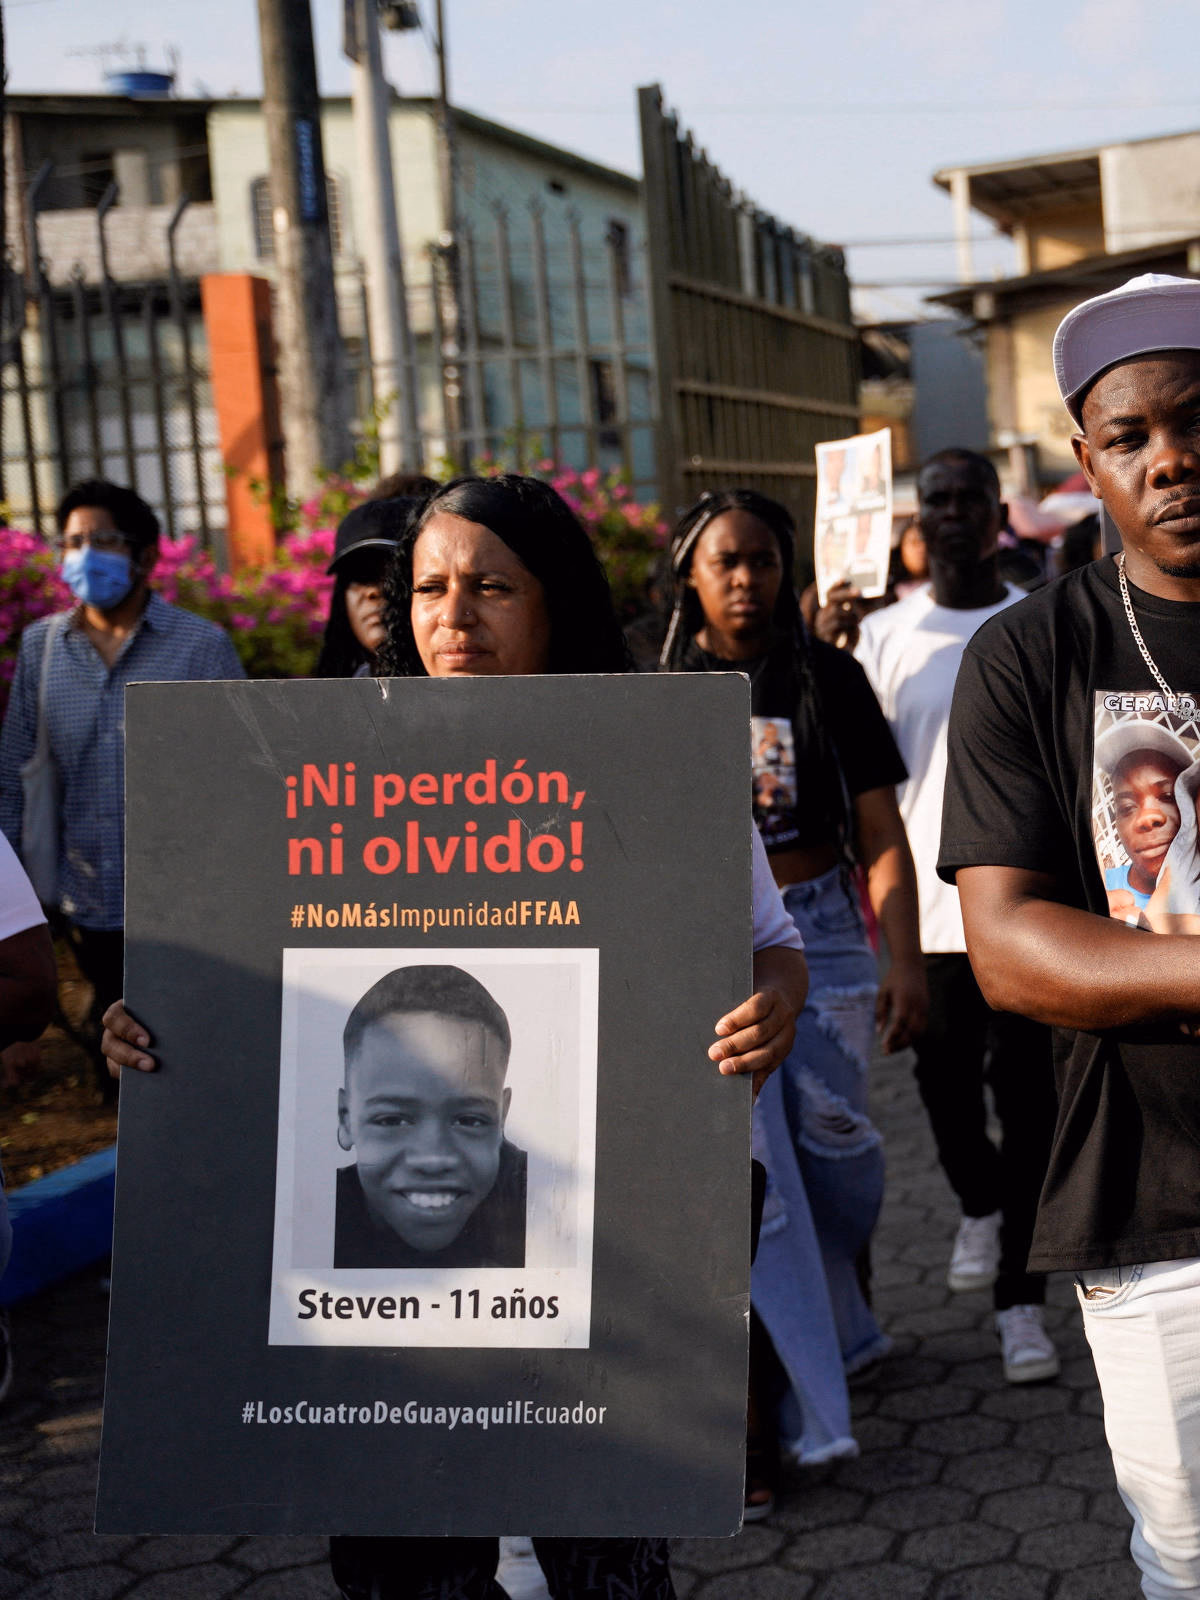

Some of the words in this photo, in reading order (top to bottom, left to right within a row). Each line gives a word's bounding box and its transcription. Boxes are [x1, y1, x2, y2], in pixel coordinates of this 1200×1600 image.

[1104, 695, 1197, 712] GERALD
[286, 762, 356, 818] ¡Ni
[373, 759, 586, 818] perdón,
[288, 822, 344, 875] ni
[363, 819, 584, 875] olvido!
[290, 900, 580, 933] #NoMásImpunidadFFAA
[298, 1289, 420, 1320] Steven
[450, 1289, 480, 1319] 11
[491, 1288, 559, 1319] años
[242, 1401, 607, 1430] #LosCuatroDeGuayaquilEcuador
